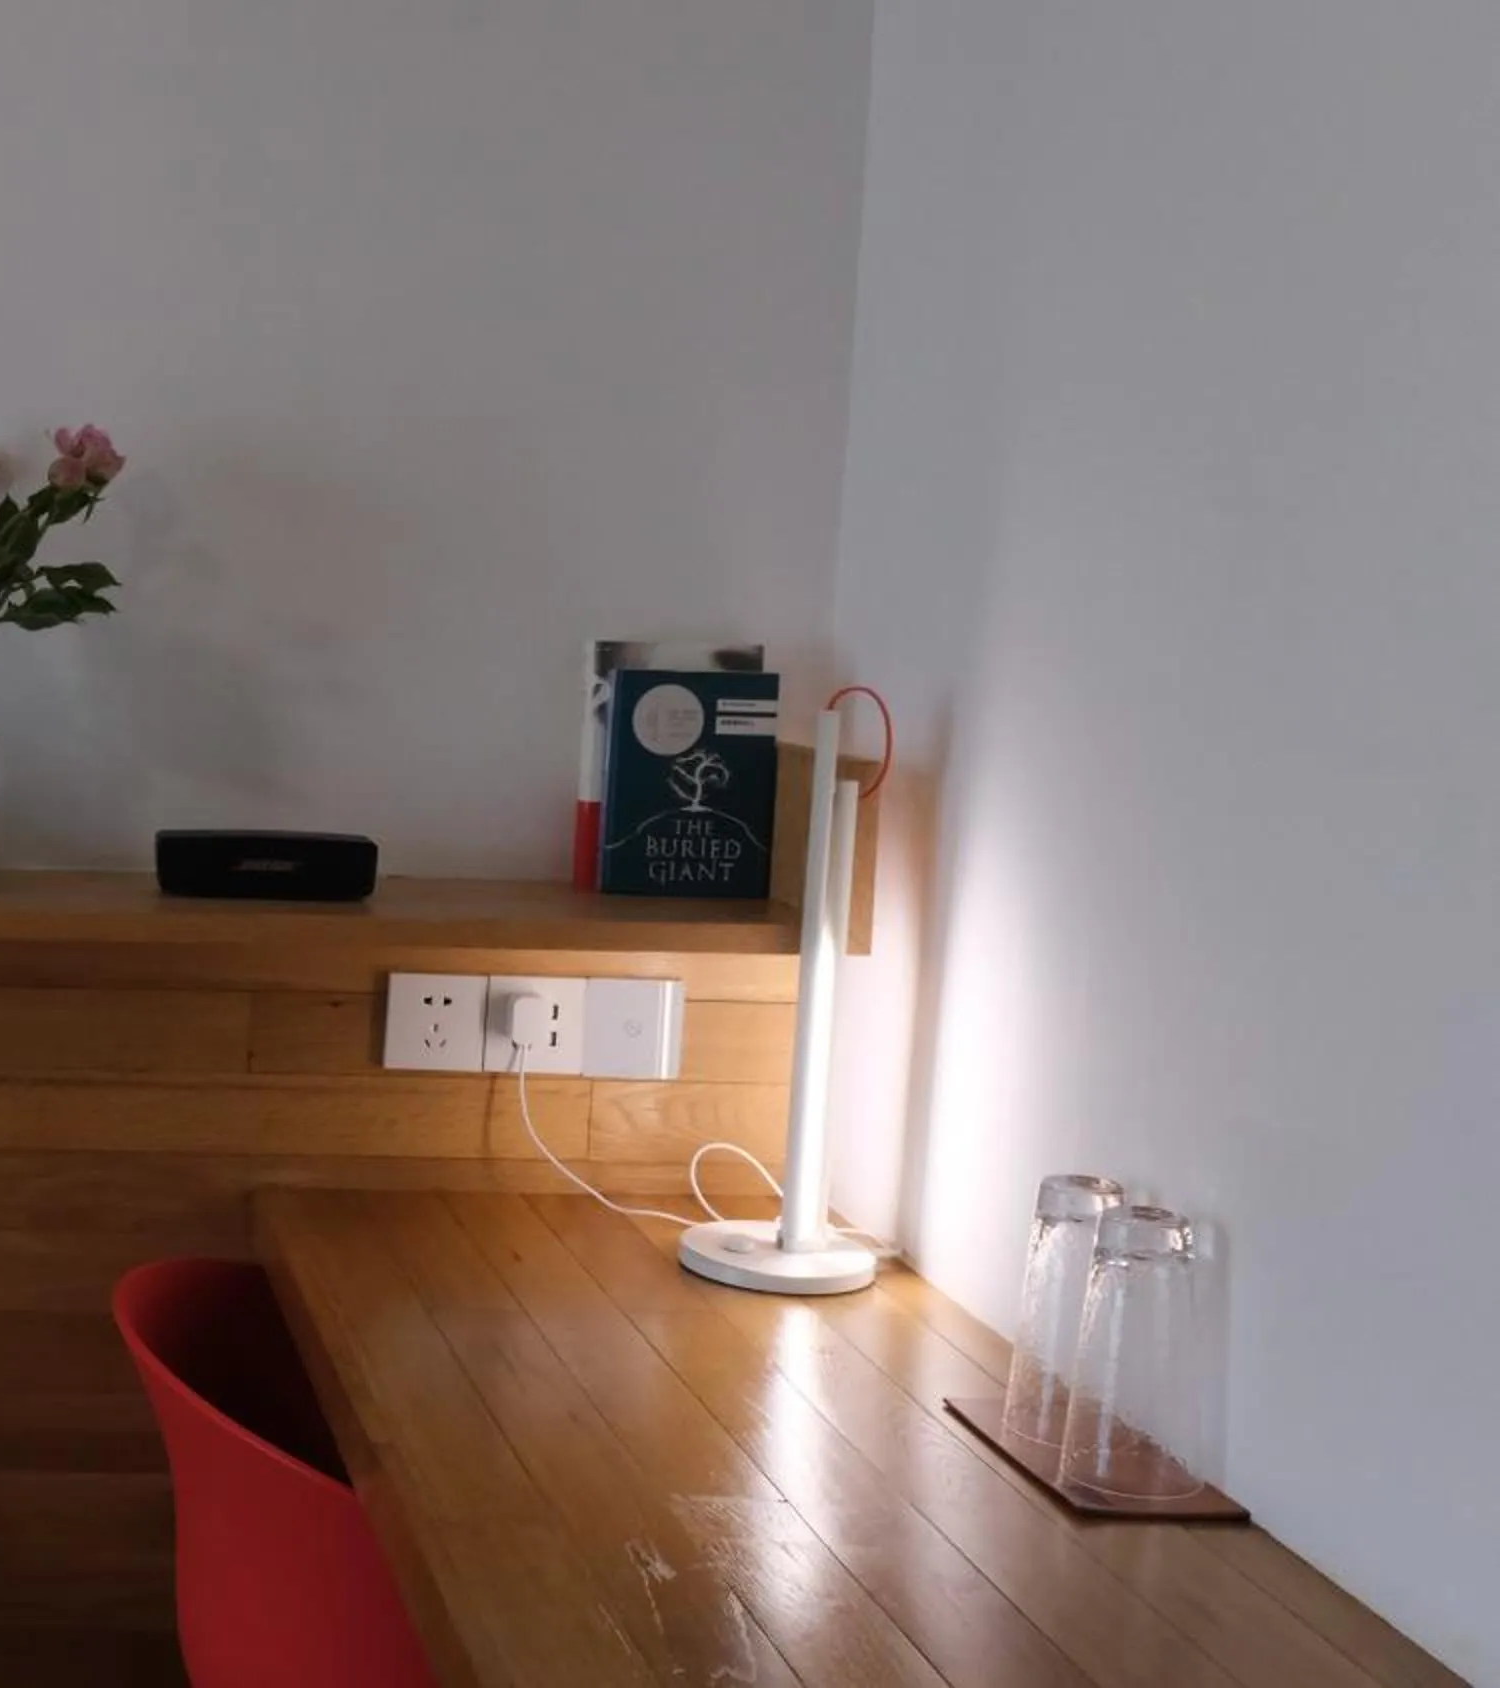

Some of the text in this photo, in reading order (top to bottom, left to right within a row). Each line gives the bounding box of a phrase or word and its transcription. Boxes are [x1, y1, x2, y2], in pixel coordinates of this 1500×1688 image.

[674, 819, 714, 835] THE
[646, 834, 742, 859] BURIED
[648, 859, 735, 884] GIANT
